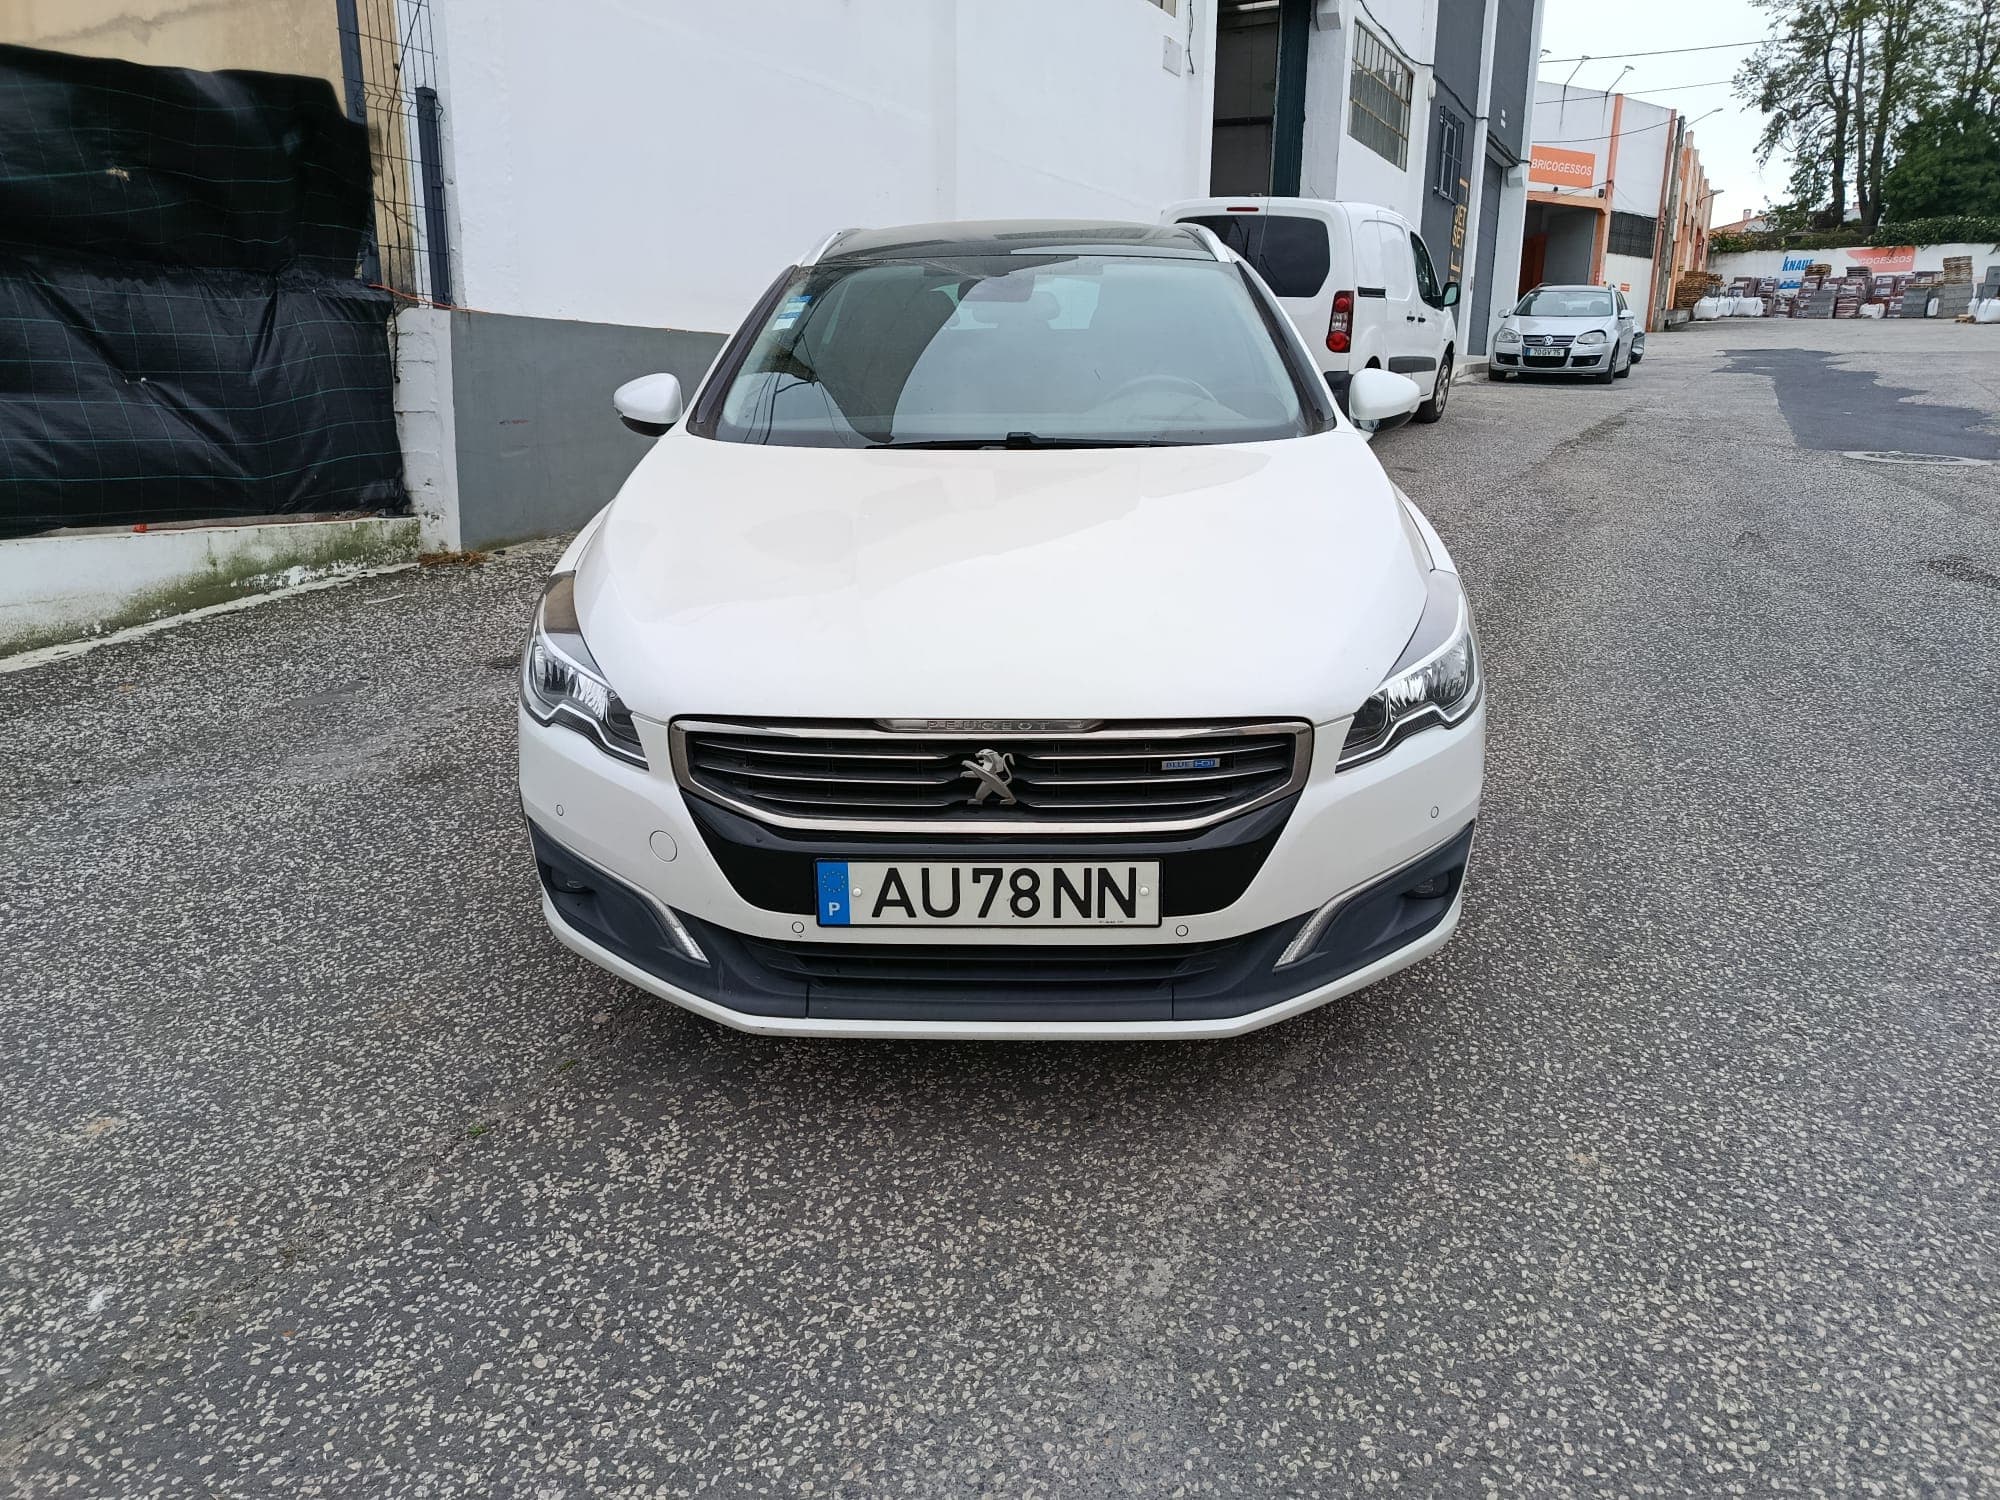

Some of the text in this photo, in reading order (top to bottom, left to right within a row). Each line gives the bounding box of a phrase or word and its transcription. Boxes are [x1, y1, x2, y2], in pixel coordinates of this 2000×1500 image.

[1530, 158, 1593, 176] BRICOGESSOS
[1452, 224, 1465, 249] SET
[926, 719, 1050, 731] PEUGEOT
[828, 867, 1137, 918] P AU78NN
